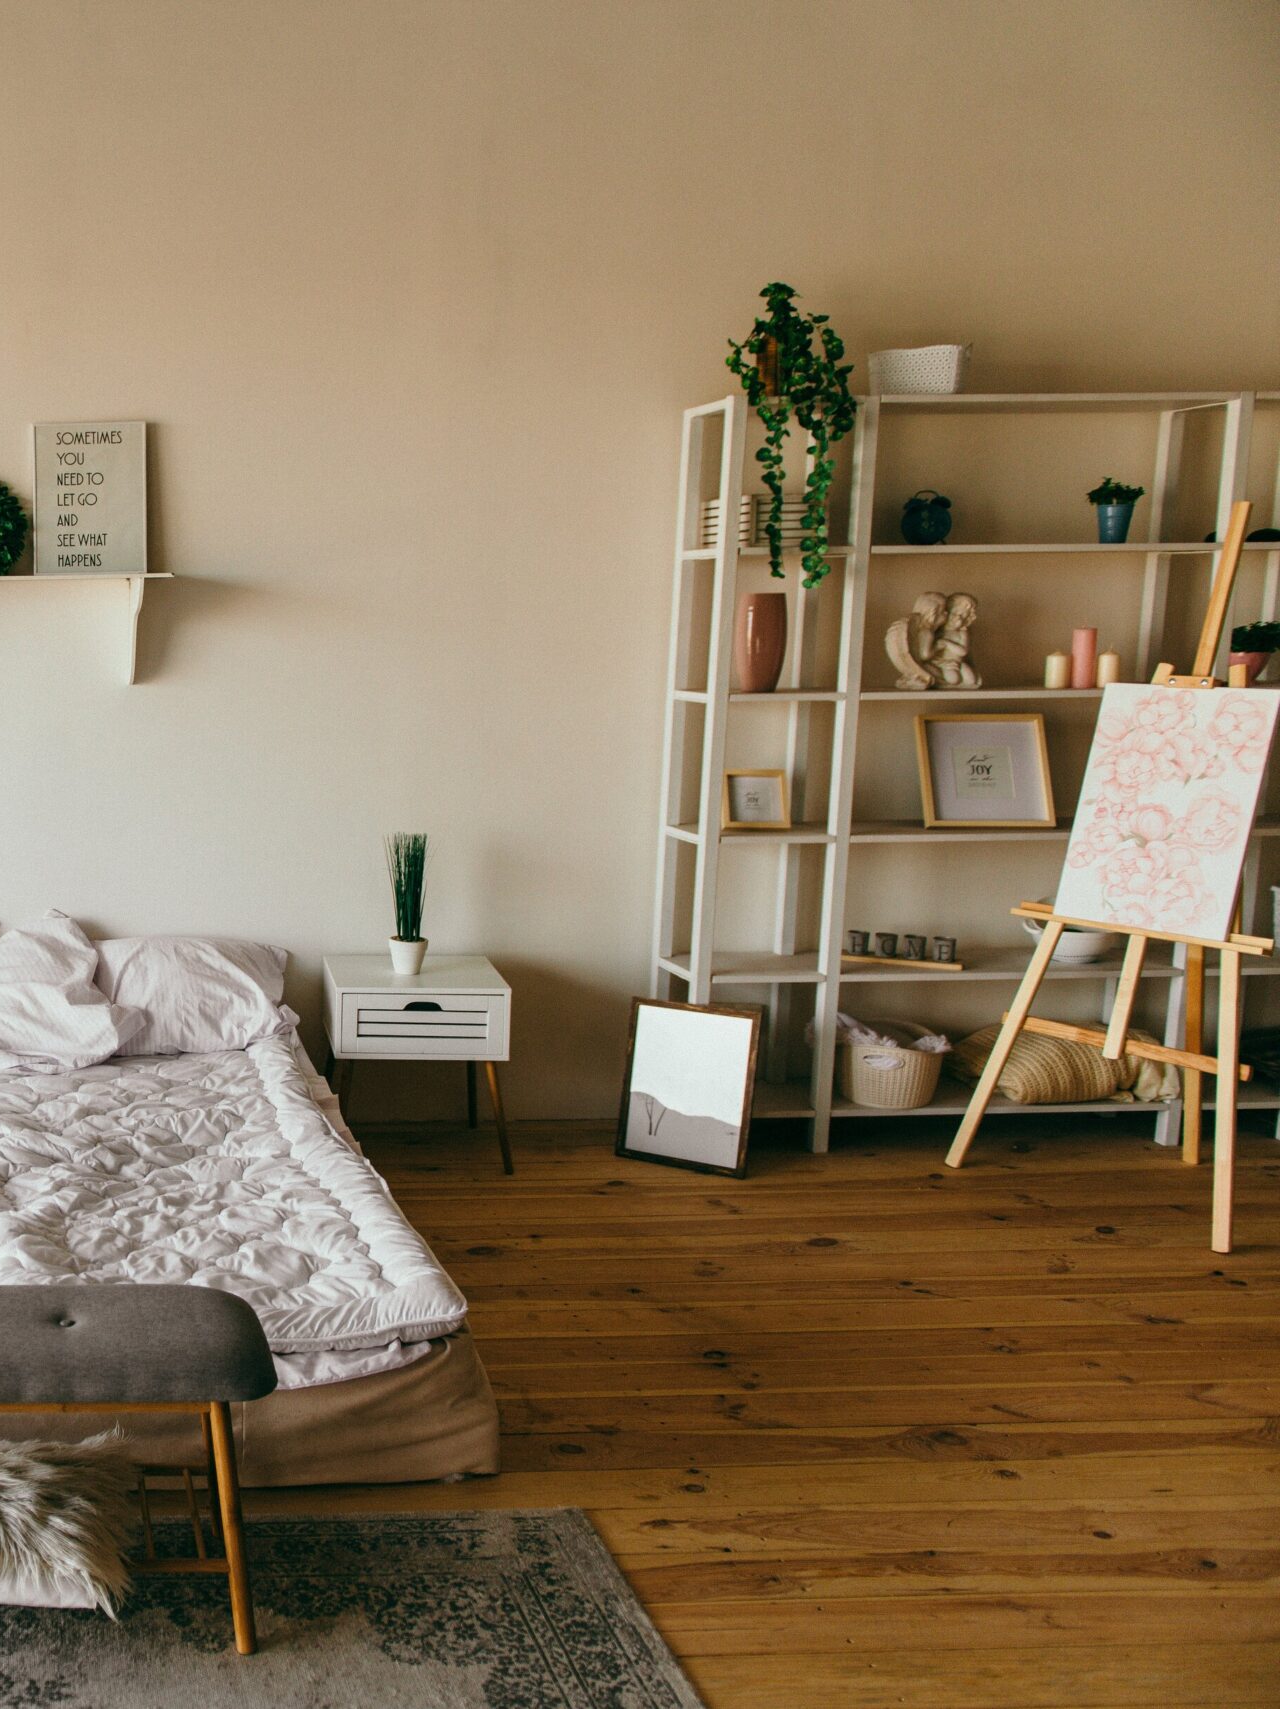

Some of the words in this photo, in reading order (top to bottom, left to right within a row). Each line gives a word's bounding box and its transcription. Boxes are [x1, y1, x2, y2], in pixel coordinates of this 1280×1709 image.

[56, 431, 122, 445] SOMETIMES
[57, 452, 85, 465] YOU
[57, 472, 84, 486] NEED
[86, 472, 104, 486] TO
[57, 493, 75, 506] LET
[78, 493, 98, 506] GO
[57, 513, 78, 527] AND
[57, 534, 75, 547] SEE
[78, 533, 108, 546] WHAT
[57, 553, 102, 567] HAPPENS
[969, 765, 993, 775] JOY
